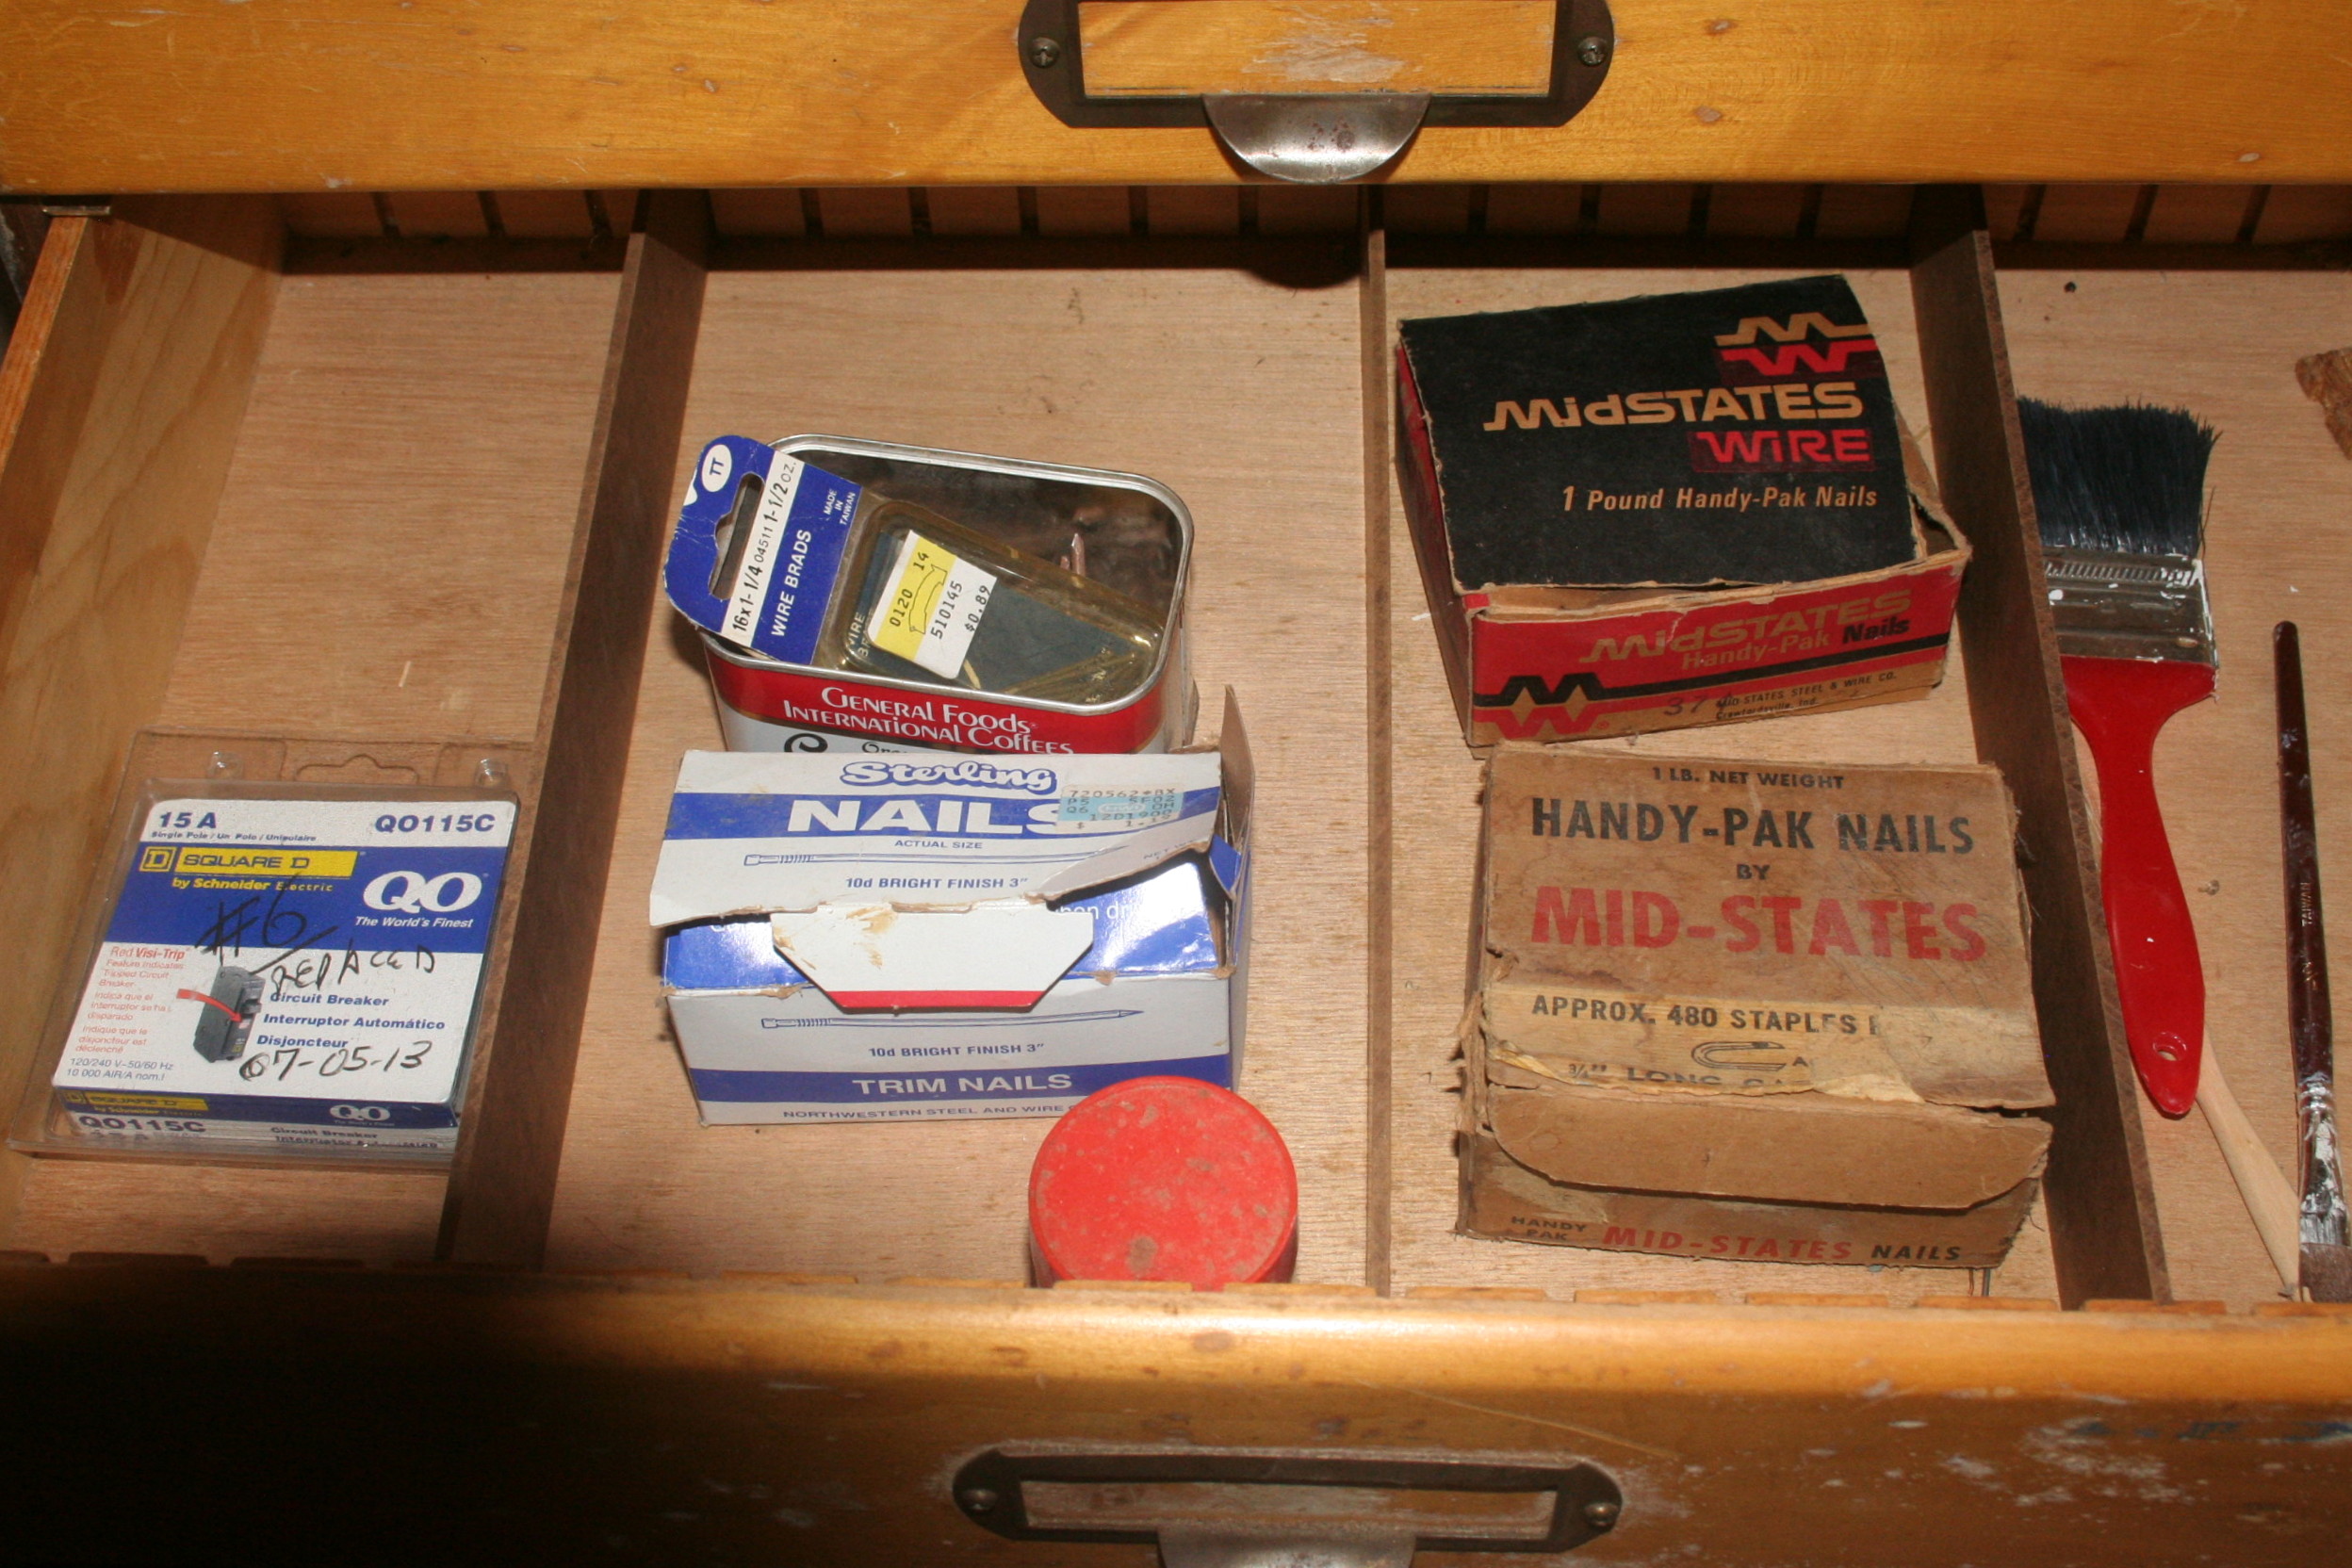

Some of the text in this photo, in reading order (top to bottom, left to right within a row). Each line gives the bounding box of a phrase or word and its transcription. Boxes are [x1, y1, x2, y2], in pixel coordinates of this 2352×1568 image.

[709, 457, 725, 476] TT
[824, 489, 838, 515] MADE
[835, 500, 844, 511] IN
[1562, 485, 1878, 513] 1 Pound Handy-Pak Nails
[840, 492, 857, 526] TAIWAN
[754, 527, 774, 564] 04511
[771, 530, 812, 637] WIRE BRADS
[889, 551, 929, 628] 14 0120
[930, 580, 963, 640] 510145
[964, 585, 990, 632] $0.89
[1682, 616, 1911, 670] Handy-Pak Nails
[1790, 685, 1822, 696] STEEL
[1829, 681, 1838, 690] &
[1844, 676, 1872, 688] WIRE
[1878, 671, 1897, 682] CO.
[942, 704, 1031, 734] Foods
[840, 760, 1057, 795] Sterling
[1653, 767, 1844, 789] 1 LB. NET WEIGHT
[159, 811, 217, 829] 15 A
[375, 814, 496, 833] QO115C
[788, 799, 1061, 835] NAILS
[1531, 797, 1975, 855] HANDY-PAK NAILS
[152, 831, 183, 841] Single
[187, 831, 208, 840] Pole
[894, 840, 948, 849] ACTUAL
[183, 854, 310, 869] SQUARE D
[1737, 863, 1771, 880] BY
[172, 877, 190, 890] by
[193, 877, 270, 890] Schneider
[363, 870, 482, 914] QO
[846, 877, 873, 889] 10d
[879, 877, 942, 889] BRIGHT
[947, 878, 1004, 889] FINISH
[2300, 881, 2313, 926] TAIWAN
[355, 916, 474, 928] The World's Finest
[1529, 885, 1988, 962] MID-STATES
[110, 946, 186, 960] Red Visi-Trip
[270, 992, 389, 1006] Circuit Breaker
[1531, 994, 1656, 1025] APPROX.
[1667, 1004, 1719, 1027] 480
[263, 1014, 445, 1030] Interruptor Automático
[256, 1035, 349, 1048] Disjoncteur
[869, 1047, 895, 1057] 10d
[901, 1046, 962, 1057] BRIGHT
[967, 1044, 1021, 1055] FINISH
[70, 1057, 112, 1067] 120/240
[159, 1062, 174, 1070] Hz
[67, 1069, 78, 1077] 10
[81, 1069, 101, 1078] 000
[852, 1073, 1072, 1094] TRIM NAILS
[330, 1104, 391, 1121] QO
[782, 1109, 922, 1119] NORTHWESTERN
[926, 1107, 978, 1116] STEEL
[1021, 1104, 1064, 1113] WIRE
[78, 1116, 206, 1133] QO115C
[1511, 1216, 1587, 1233] HANDY
[1527, 1229, 1568, 1240] PAK
[1603, 1226, 1961, 1262] MID-STATES NAILS
